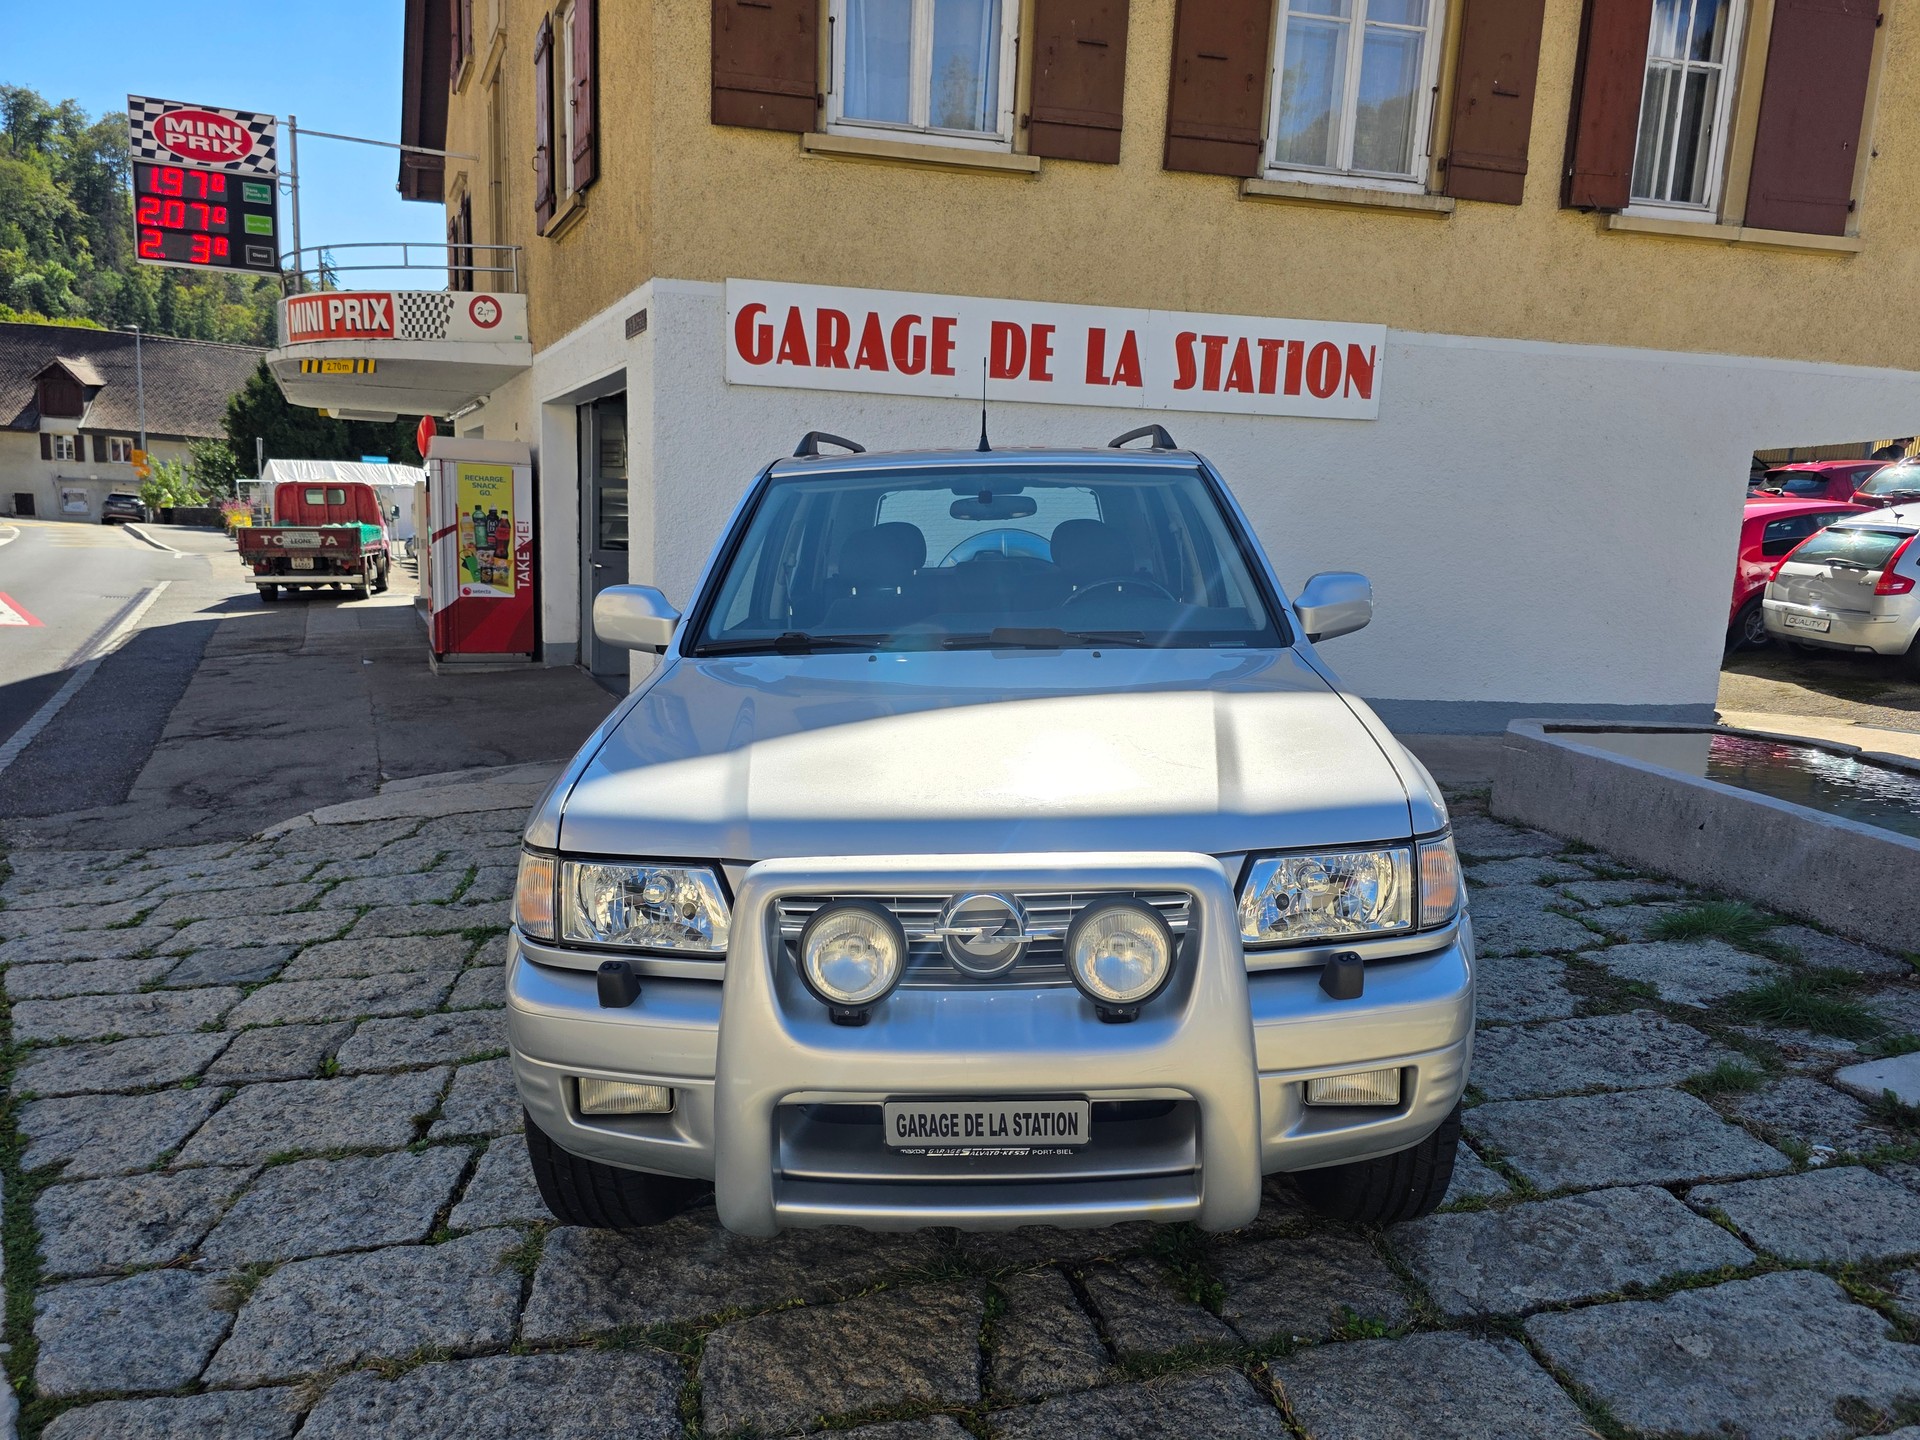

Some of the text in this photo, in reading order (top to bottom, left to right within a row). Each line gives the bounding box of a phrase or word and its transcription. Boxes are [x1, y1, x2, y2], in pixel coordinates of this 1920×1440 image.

[164, 116, 243, 141] MINI
[165, 132, 244, 156] PRIX
[290, 297, 391, 335] MINI PRIX
[734, 302, 1377, 400] GARAGE DE LA STATION
[464, 474, 507, 484] RECHARGE.
[471, 482, 499, 490] SNACK.
[479, 489, 493, 497] GO.
[516, 520, 531, 590] TAKE ME!
[896, 1111, 1079, 1138] GARAGE DE LA STATION
